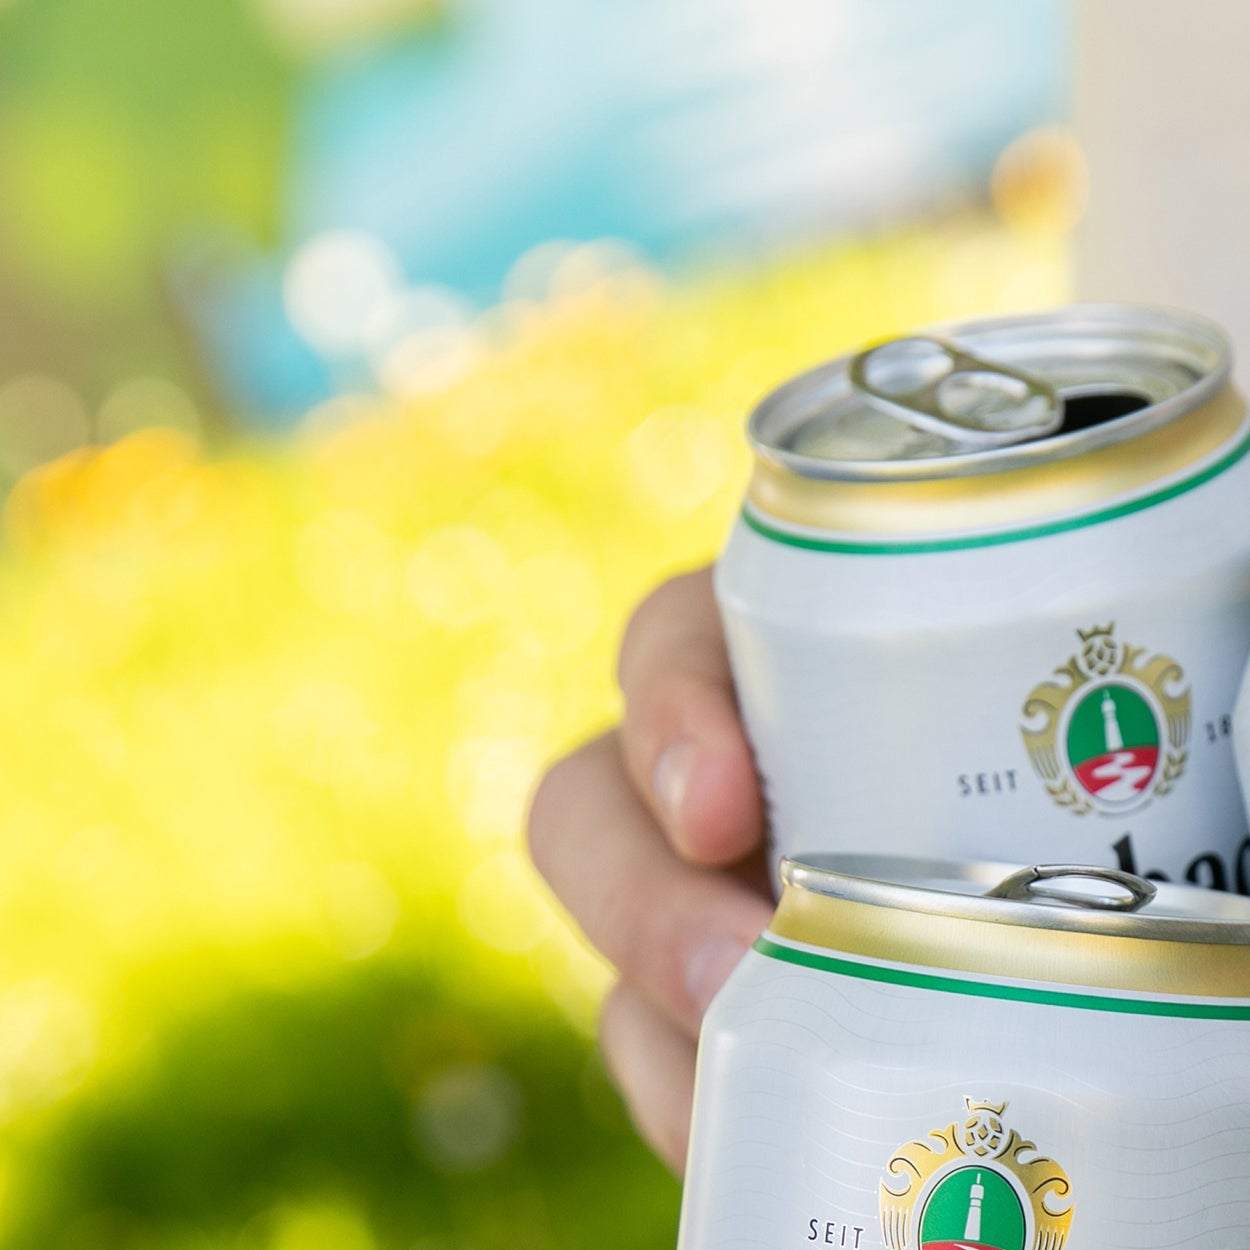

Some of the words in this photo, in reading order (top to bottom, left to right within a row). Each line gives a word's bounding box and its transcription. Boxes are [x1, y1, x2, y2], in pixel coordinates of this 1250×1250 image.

[957, 769, 1018, 797] SEIT
[1206, 714, 1232, 744] 18
[807, 1218, 864, 1249] SEIT
